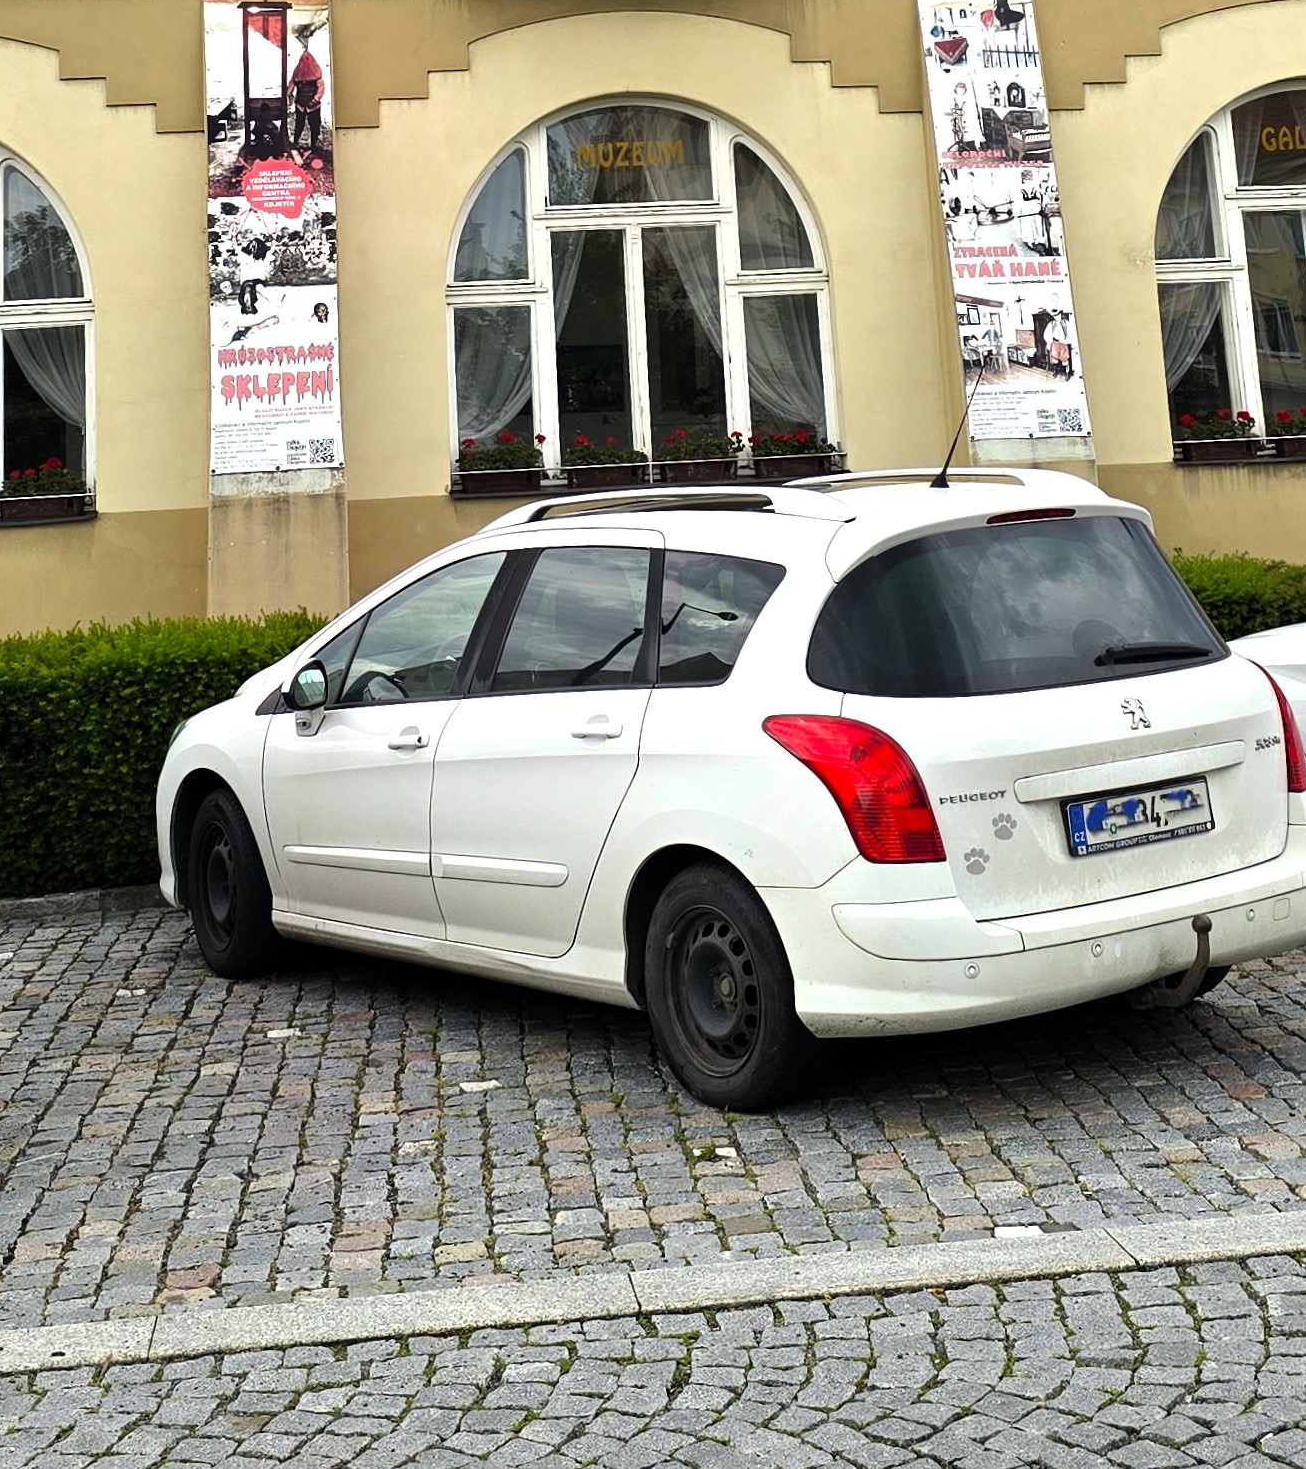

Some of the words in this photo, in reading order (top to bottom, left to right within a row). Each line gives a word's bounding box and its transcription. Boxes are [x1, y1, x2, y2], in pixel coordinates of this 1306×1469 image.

[576, 139, 684, 168] MUZEUM
[954, 244, 1018, 258] ZTRACENÁ
[955, 260, 1006, 278] TVÁŘ
[1010, 258, 1061, 277] HANÉ
[220, 363, 334, 411] SKLEPENÍ
[939, 790, 1007, 805] PEUGEOT
[1074, 831, 1086, 843] CZ
[1088, 841, 1115, 853] ARTCOM
